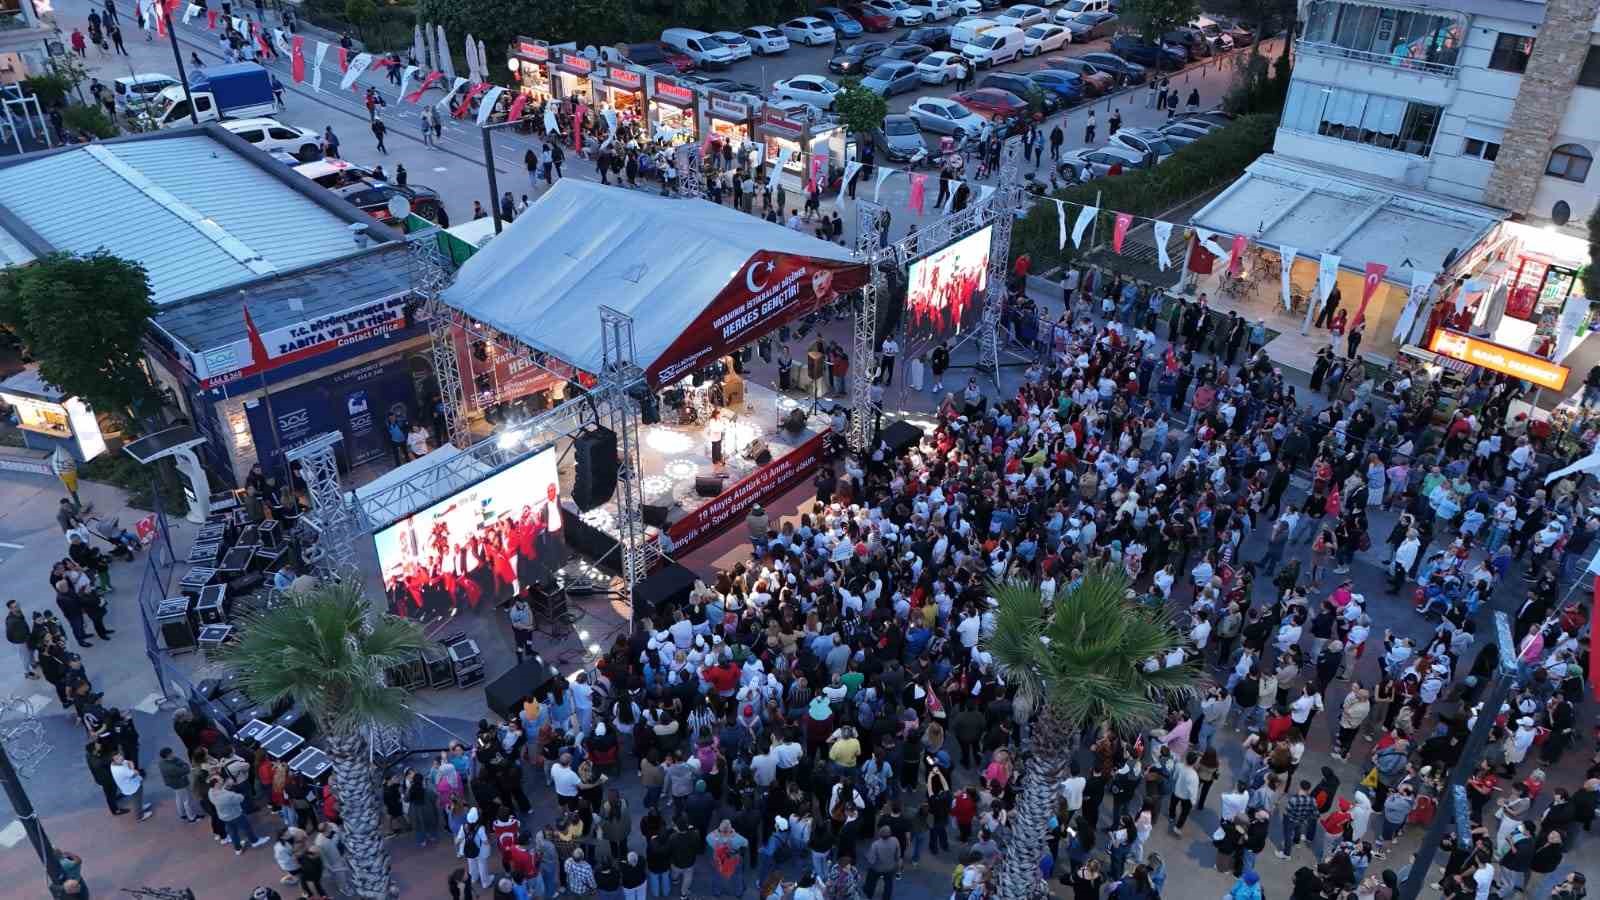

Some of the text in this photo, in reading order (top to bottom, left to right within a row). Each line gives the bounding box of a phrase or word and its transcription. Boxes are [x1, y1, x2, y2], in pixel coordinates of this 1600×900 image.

[722, 309, 759, 338] HERKES
[761, 282, 799, 315] GENÇTİR!
[279, 309, 397, 354] ZABITA VE İLETİŞİM
[337, 322, 399, 347] Contact Office
[698, 509, 708, 522] 19
[709, 495, 733, 515] Mayıs
[712, 509, 729, 526] Spor
